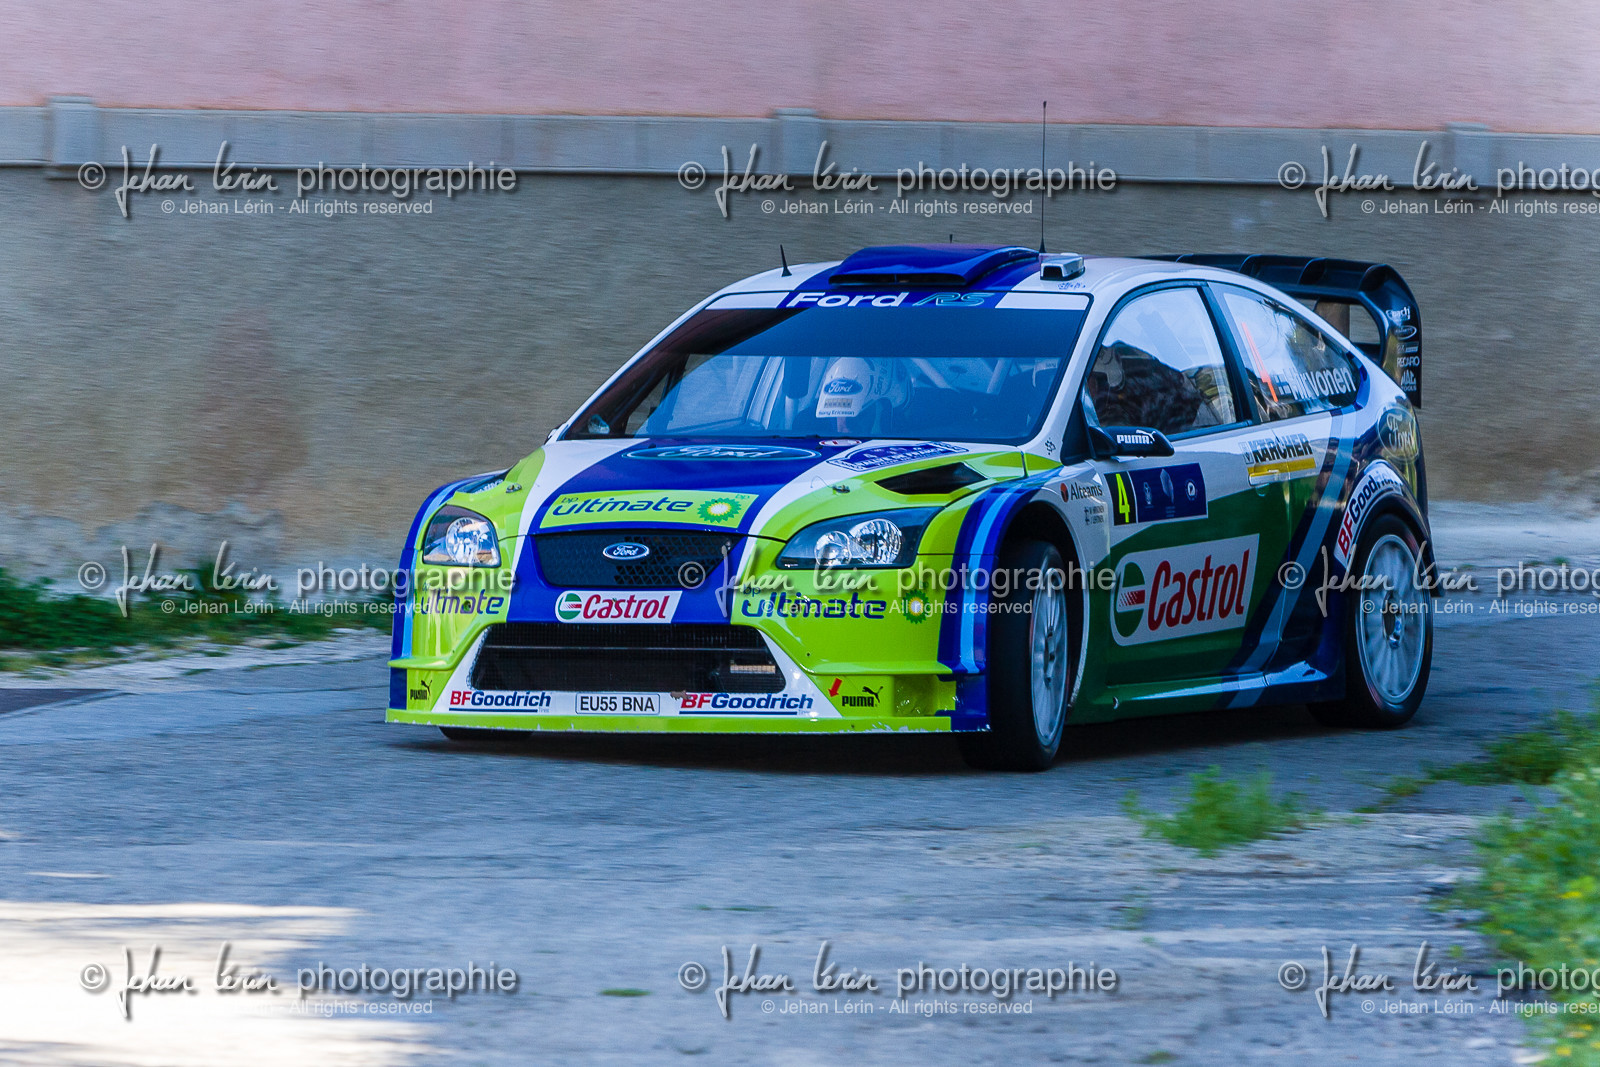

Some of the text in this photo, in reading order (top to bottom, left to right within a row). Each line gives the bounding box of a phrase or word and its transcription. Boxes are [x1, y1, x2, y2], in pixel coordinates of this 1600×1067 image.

[786, 291, 995, 308] Ford RS
[1396, 356, 1420, 368] RECARO
[828, 380, 853, 393] Ford
[1116, 434, 1150, 444] PUMA
[1386, 412, 1418, 452] Ford
[656, 446, 783, 458] Ford
[1070, 481, 1103, 500] Alteams
[1116, 473, 1130, 523] 4
[552, 496, 693, 516] ultimate
[612, 544, 639, 556] Ford
[1148, 548, 1250, 632] Castrol
[583, 594, 670, 619] Castrol
[741, 591, 887, 619] ultimate
[450, 690, 551, 707] BFGoodrich
[580, 696, 655, 711] EU55 BNA
[681, 693, 814, 709] BFGoodrich
[841, 695, 876, 707] PUMA
